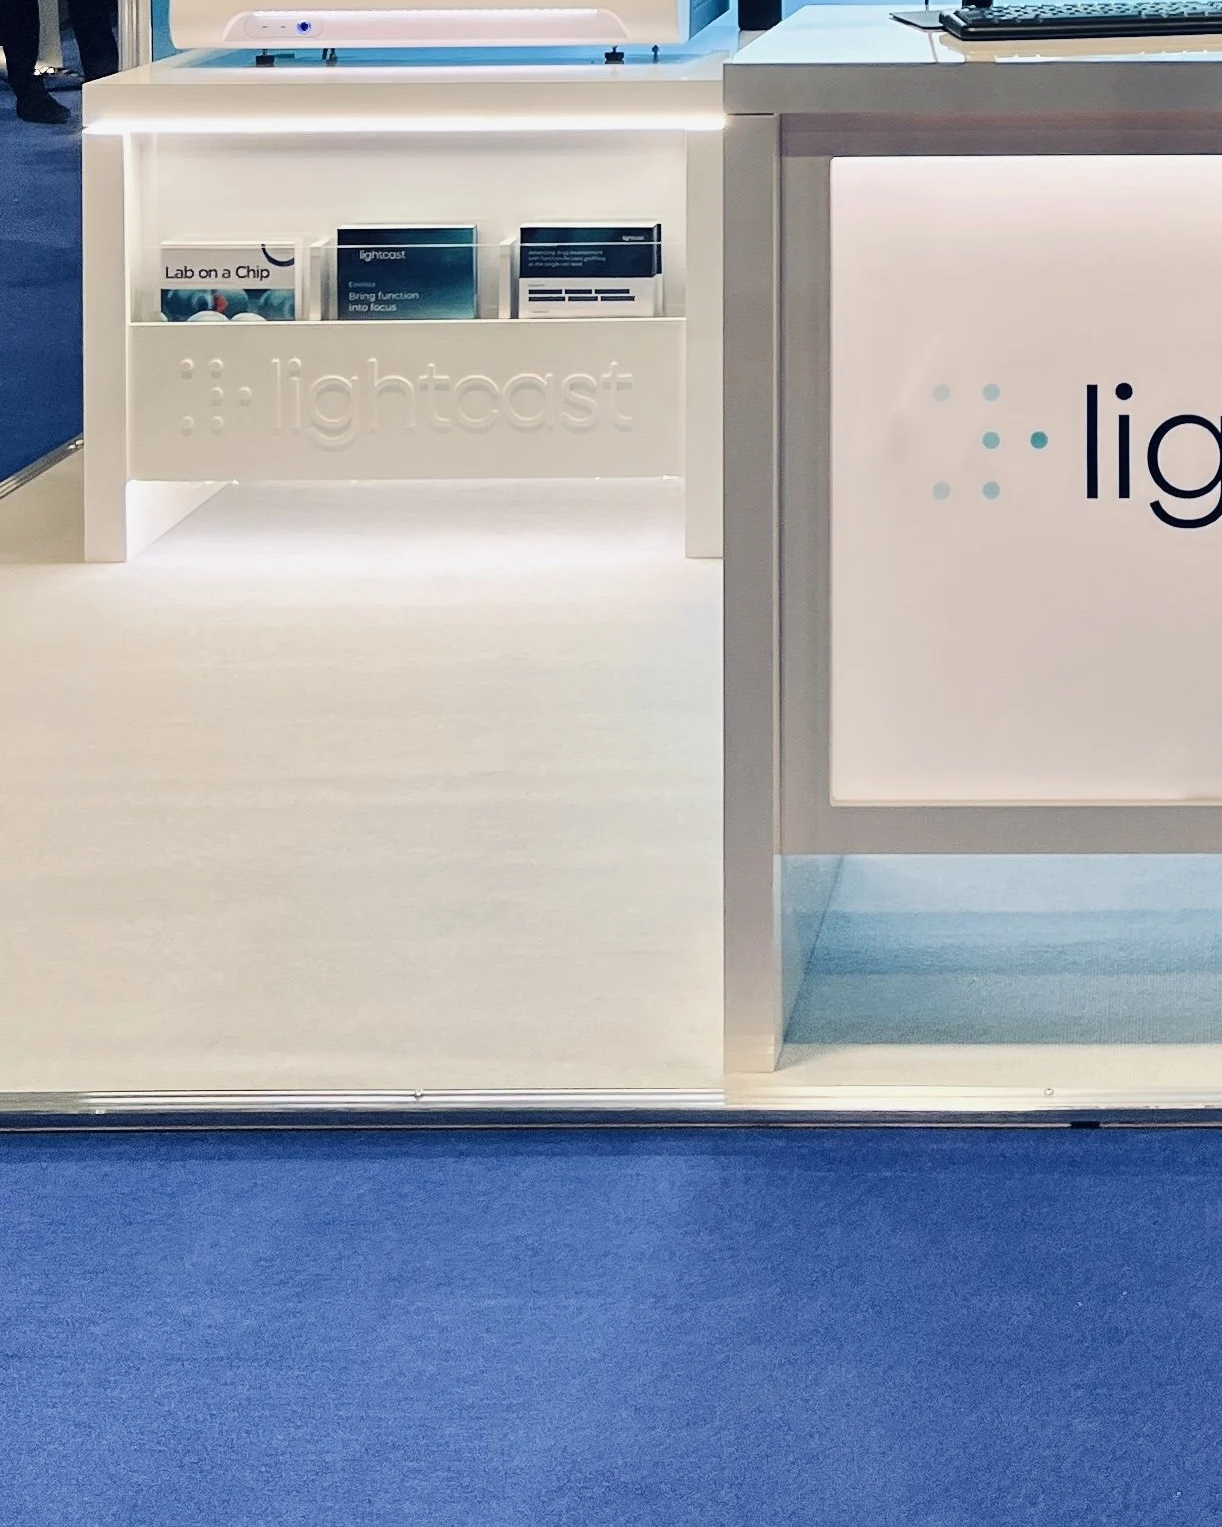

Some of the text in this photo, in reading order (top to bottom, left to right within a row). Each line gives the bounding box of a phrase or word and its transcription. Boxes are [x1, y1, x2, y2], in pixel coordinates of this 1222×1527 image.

[359, 250, 406, 262] lightcast
[165, 265, 270, 281] Lab on a Chip
[348, 291, 419, 302] Bring function
[348, 303, 397, 312] into focus
[272, 357, 633, 450] lightcast
